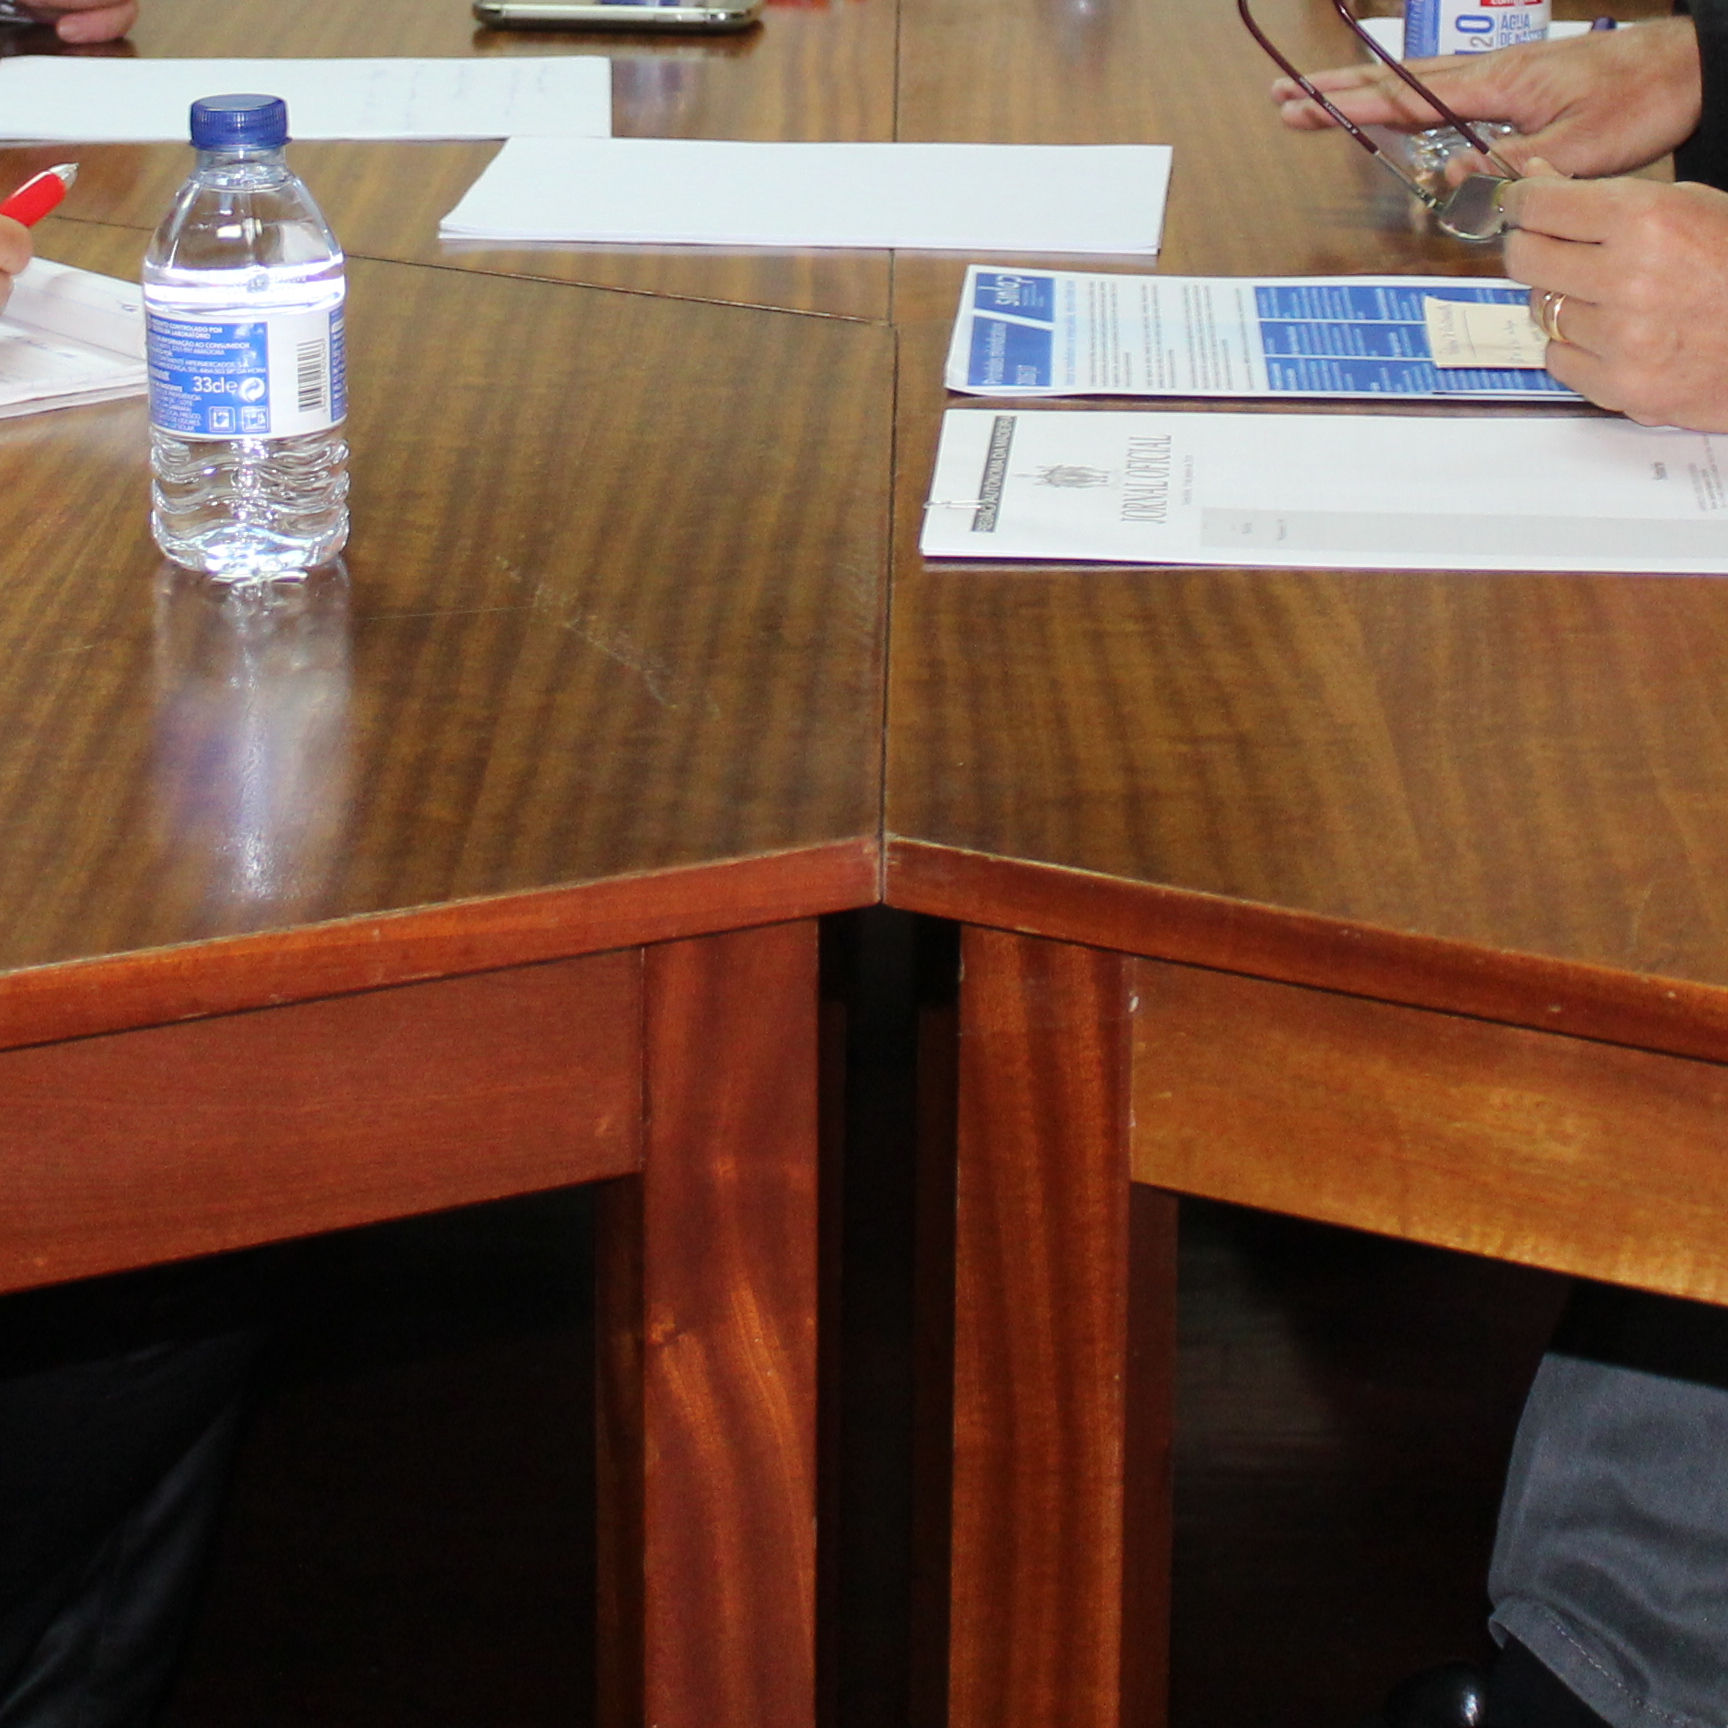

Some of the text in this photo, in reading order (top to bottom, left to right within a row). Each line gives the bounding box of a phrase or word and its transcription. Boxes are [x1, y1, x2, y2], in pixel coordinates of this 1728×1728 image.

[1501, 11, 1531, 30] ÁGUA
[1120, 434, 1172, 525] JORNAL OFICIAL
